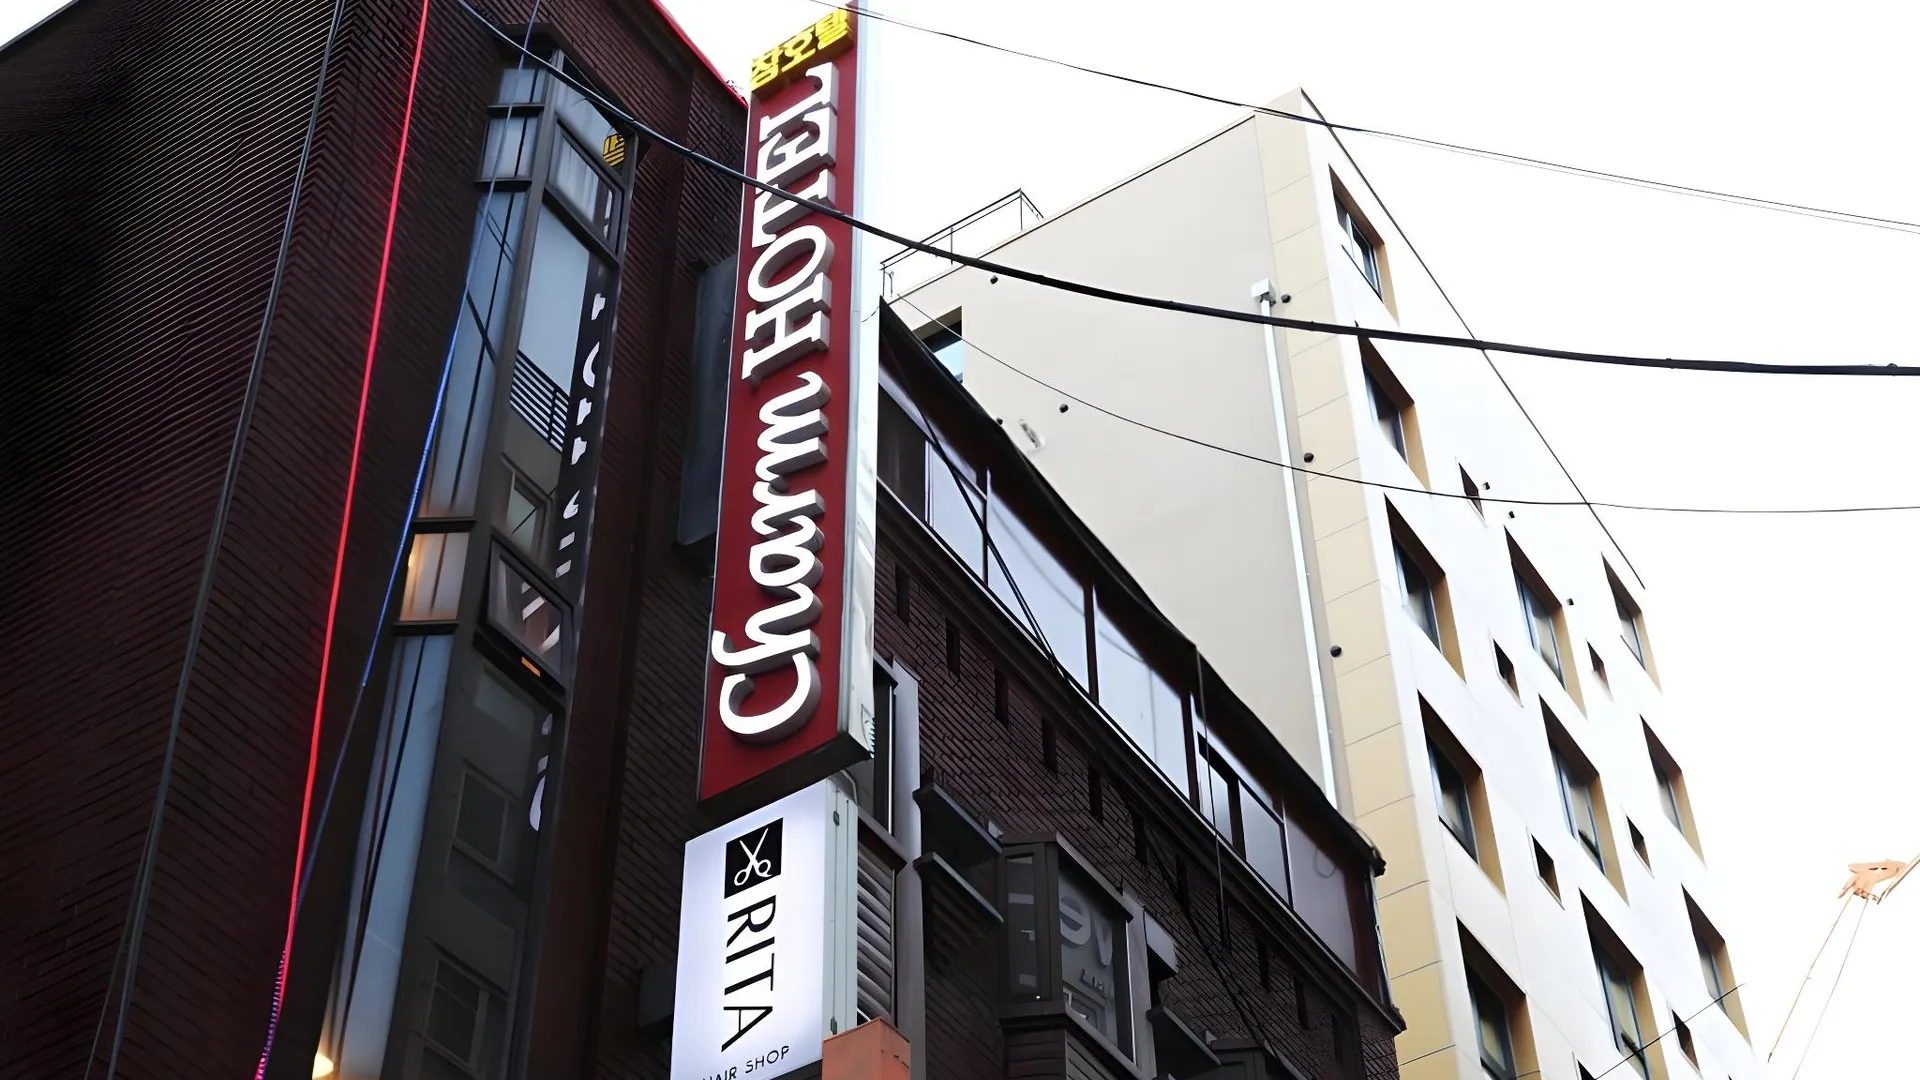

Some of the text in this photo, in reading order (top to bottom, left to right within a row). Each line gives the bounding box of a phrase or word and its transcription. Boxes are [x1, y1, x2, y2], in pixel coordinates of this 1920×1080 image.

[711, 62, 836, 737] Charm HOTEL
[721, 895, 777, 1053] RITA
[702, 1045, 790, 1080] AIR SHOP
